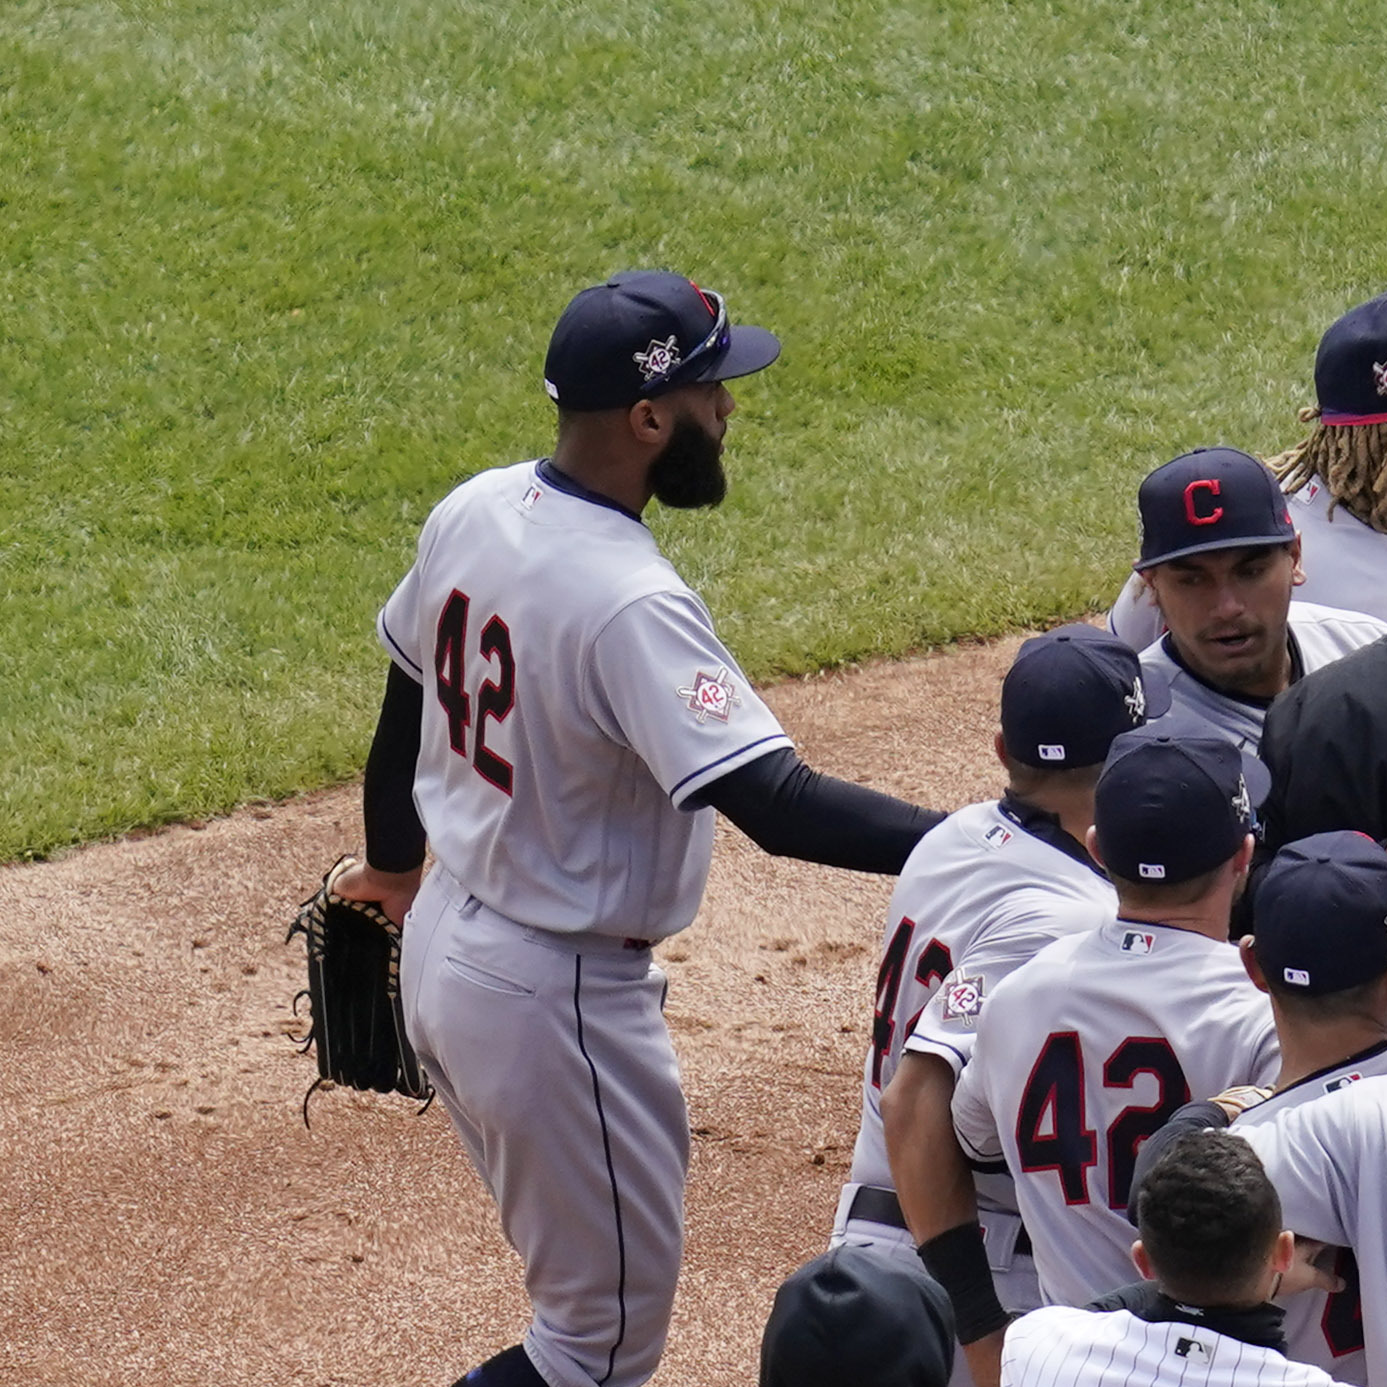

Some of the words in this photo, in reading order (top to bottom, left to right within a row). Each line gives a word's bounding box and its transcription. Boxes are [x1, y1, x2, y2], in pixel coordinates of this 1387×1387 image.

[651, 350, 669, 370] 42
[1183, 479, 1224, 525] C
[435, 587, 515, 798] 42
[702, 684, 724, 705] 42
[953, 987, 975, 1009] 42
[1016, 1031, 1193, 1210] 42
